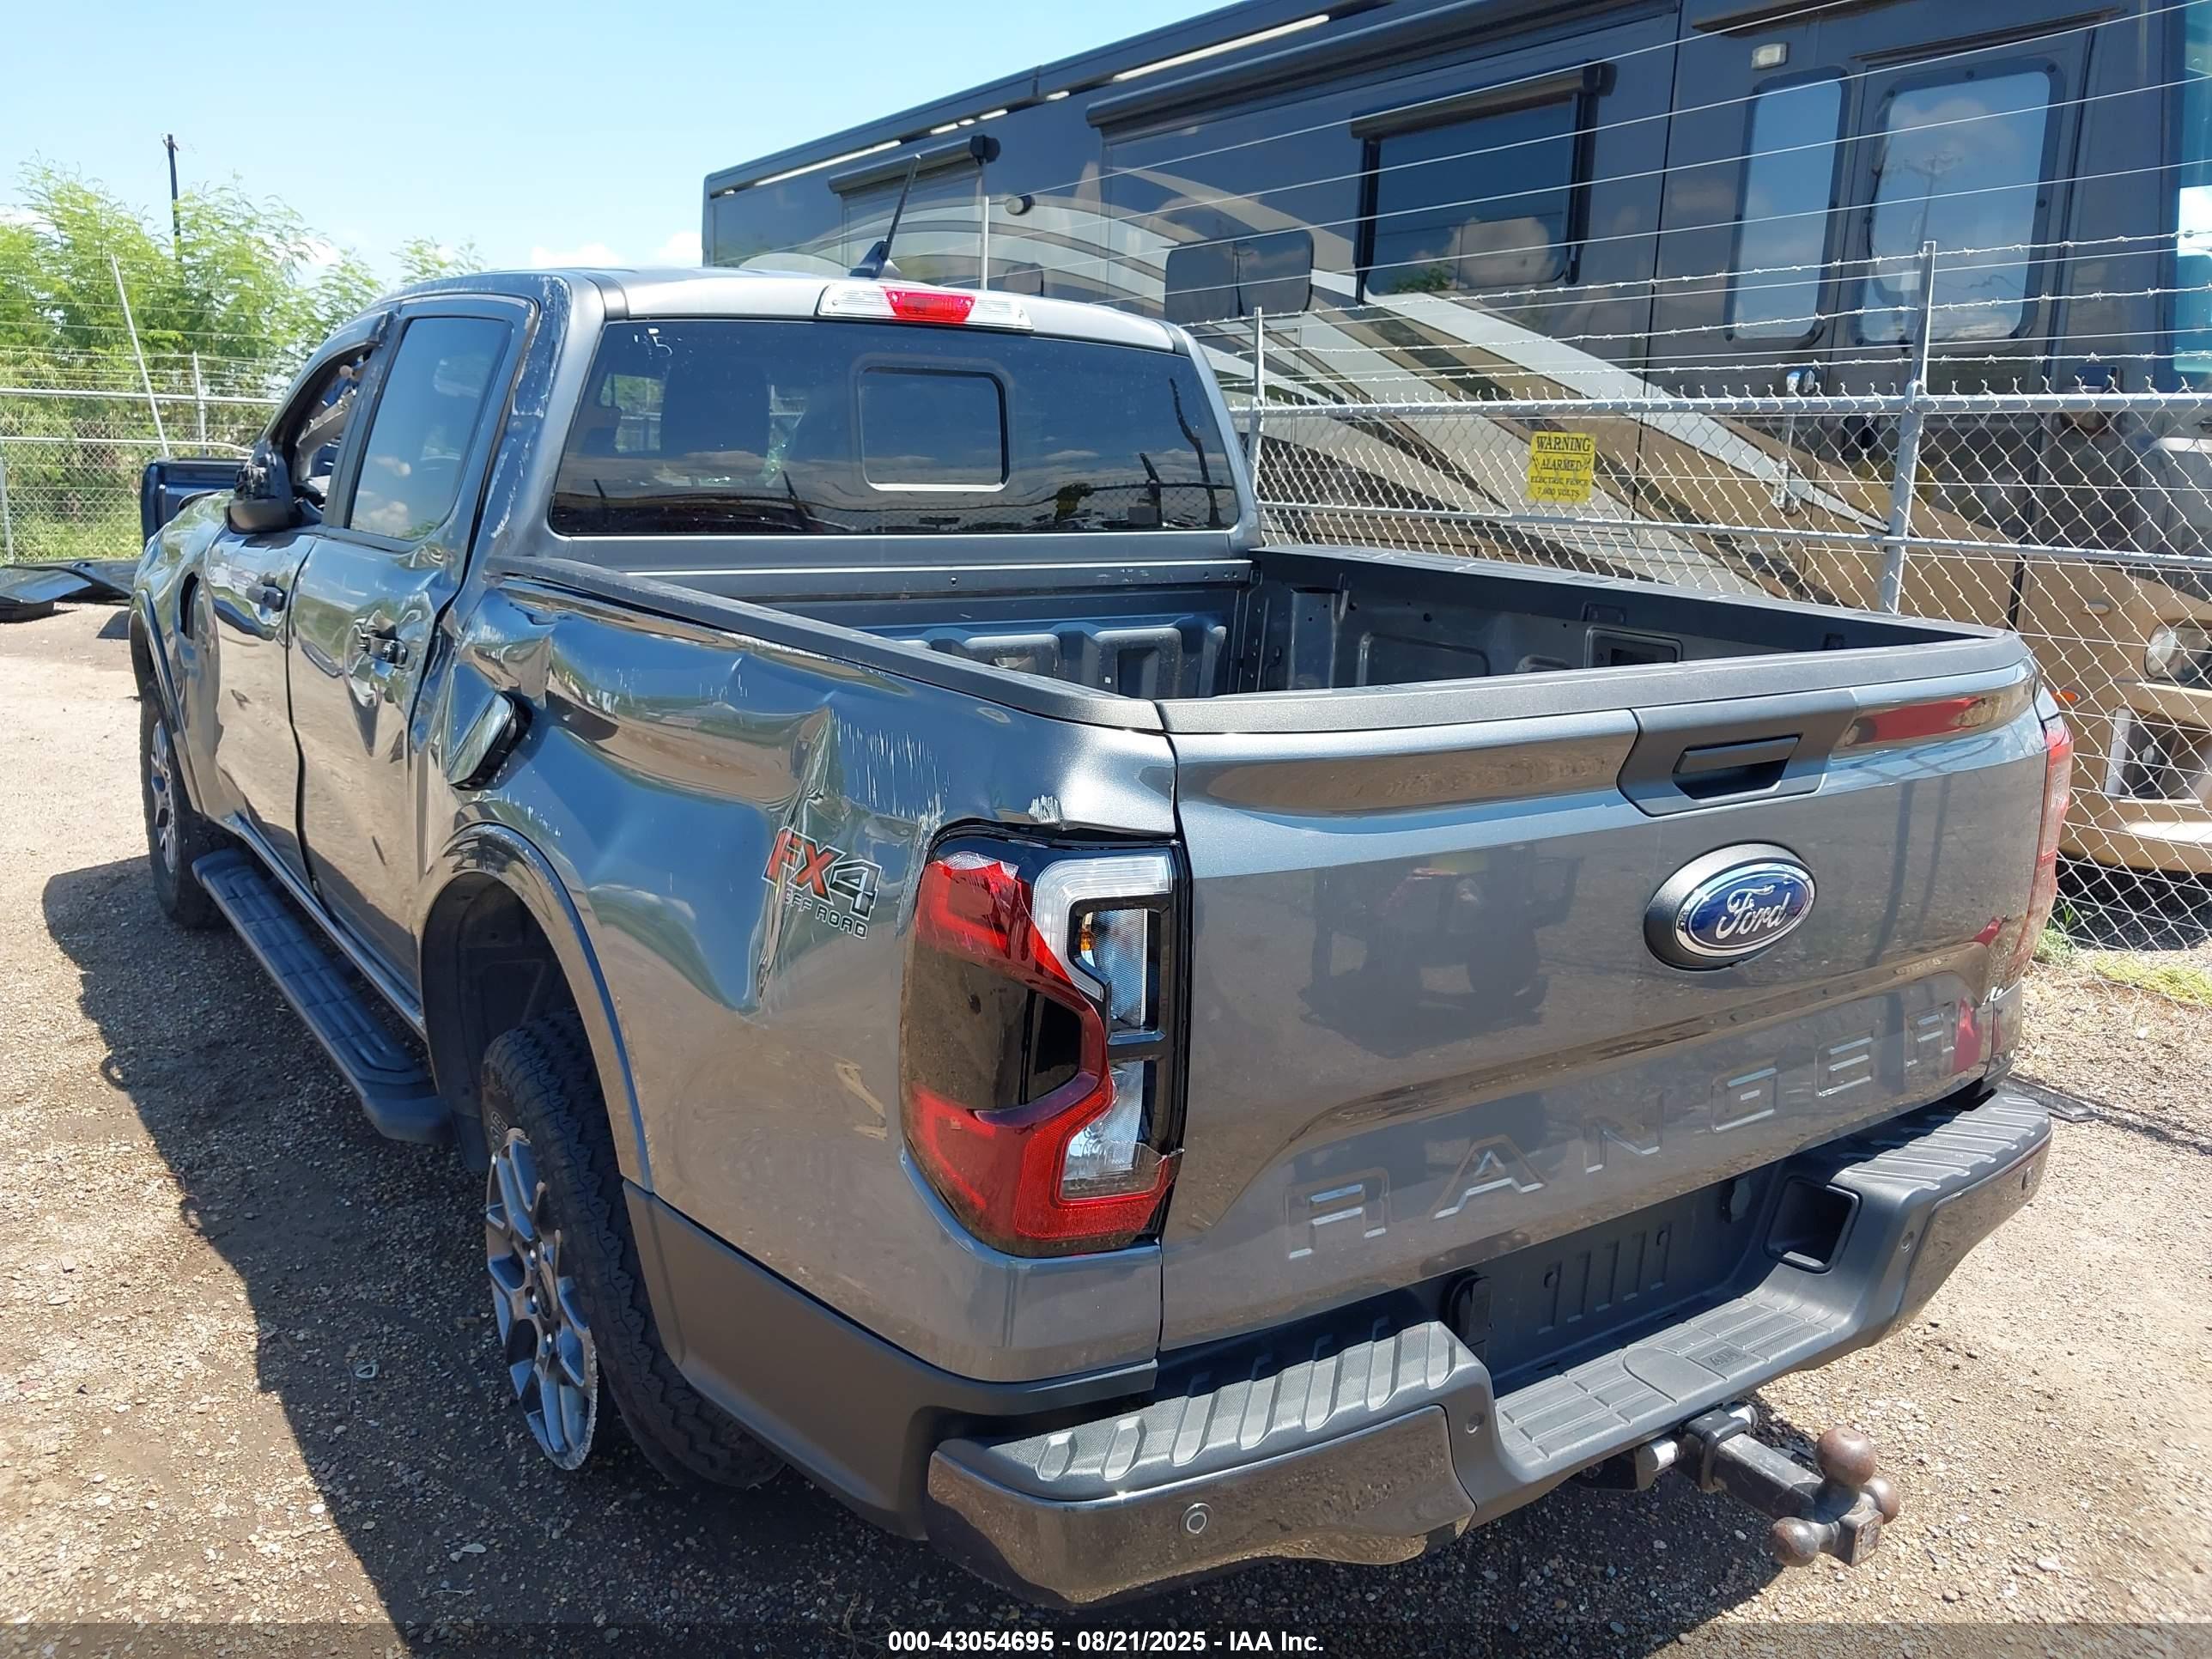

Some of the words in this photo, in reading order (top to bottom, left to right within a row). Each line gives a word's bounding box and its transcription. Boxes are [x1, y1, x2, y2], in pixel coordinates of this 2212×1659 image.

[1536, 436, 1591, 452] WARNING
[1530, 476, 1564, 485] ELECTRIC
[1565, 478, 1589, 487] FENCE
[1540, 458, 1582, 471] ALARMED
[1557, 488, 1580, 496] VOLTS
[761, 826, 883, 921] FX4
[784, 888, 813, 913] OFF
[815, 904, 869, 940] ROAD
[1715, 883, 1791, 940] Ford
[1284, 1001, 1956, 1260] RANGER
